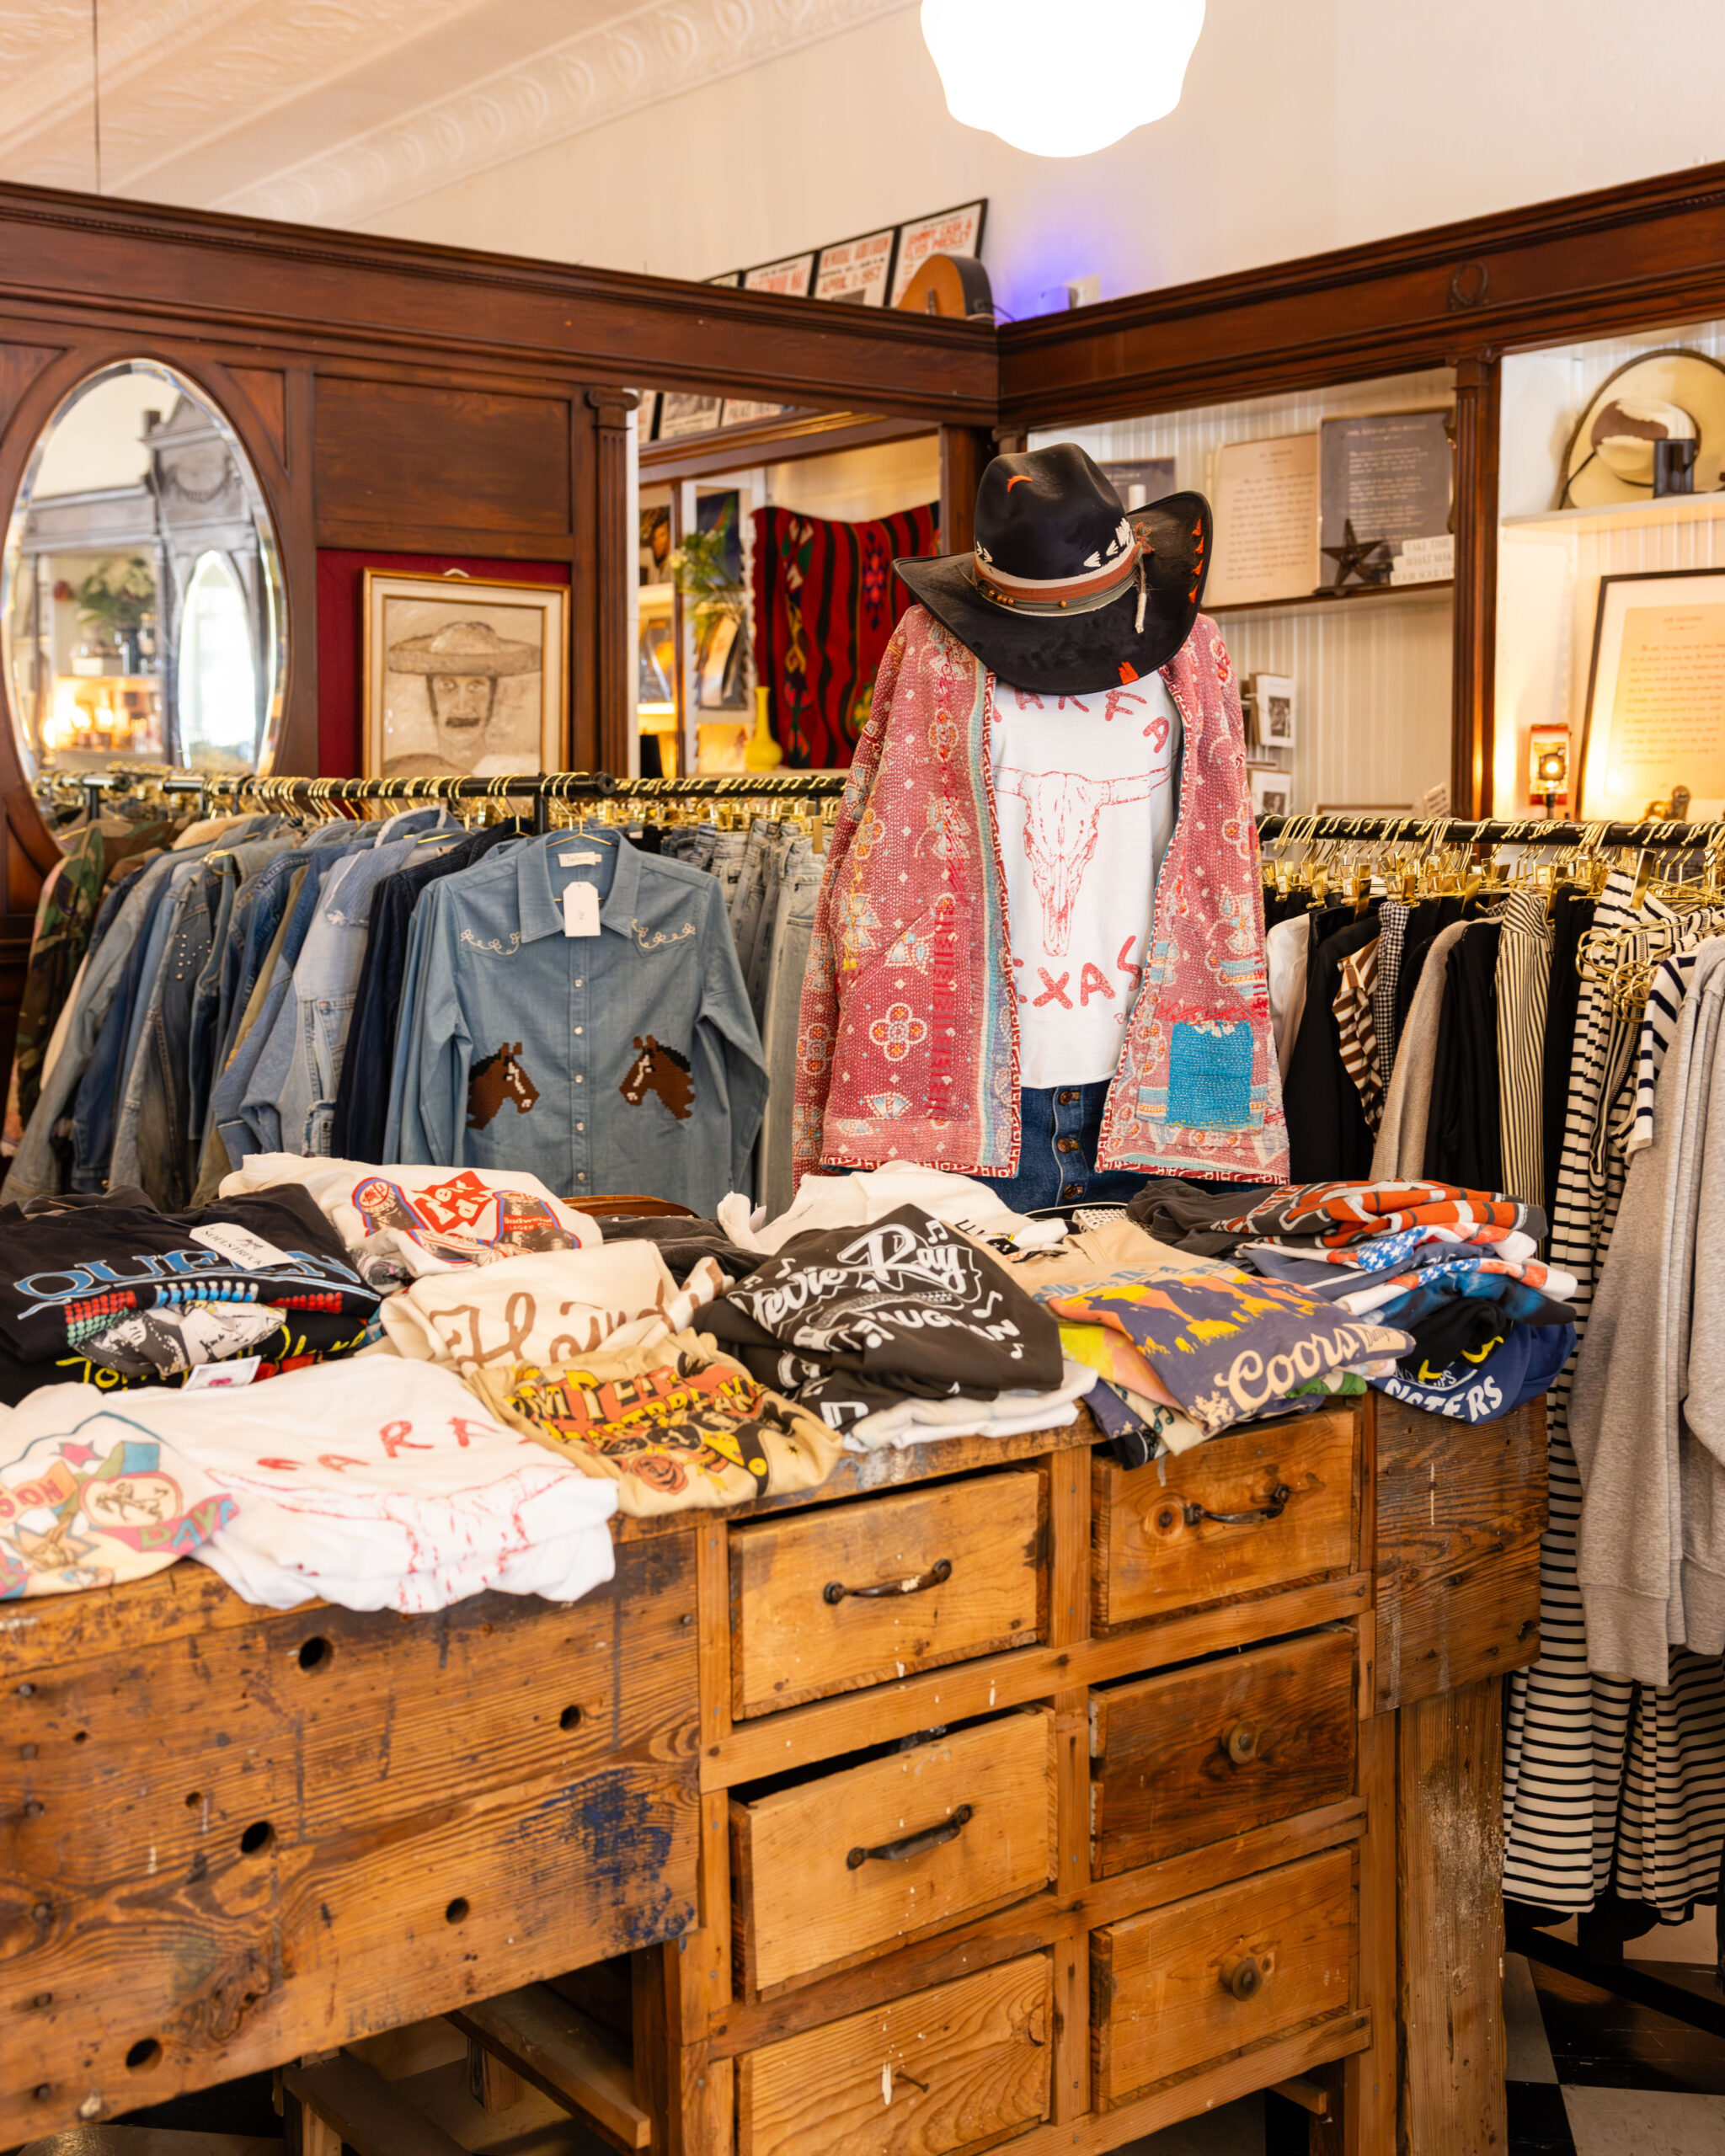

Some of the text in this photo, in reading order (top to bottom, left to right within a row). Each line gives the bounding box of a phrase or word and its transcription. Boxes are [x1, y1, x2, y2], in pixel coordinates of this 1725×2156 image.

[993, 689, 1170, 754] ARFA
[1012, 935, 1144, 1011] XAS
[836, 1223, 968, 1295] Ray
[726, 1265, 848, 1326] tevie
[1213, 1326, 1360, 1412] Coors
[256, 1417, 525, 1473] ARF
